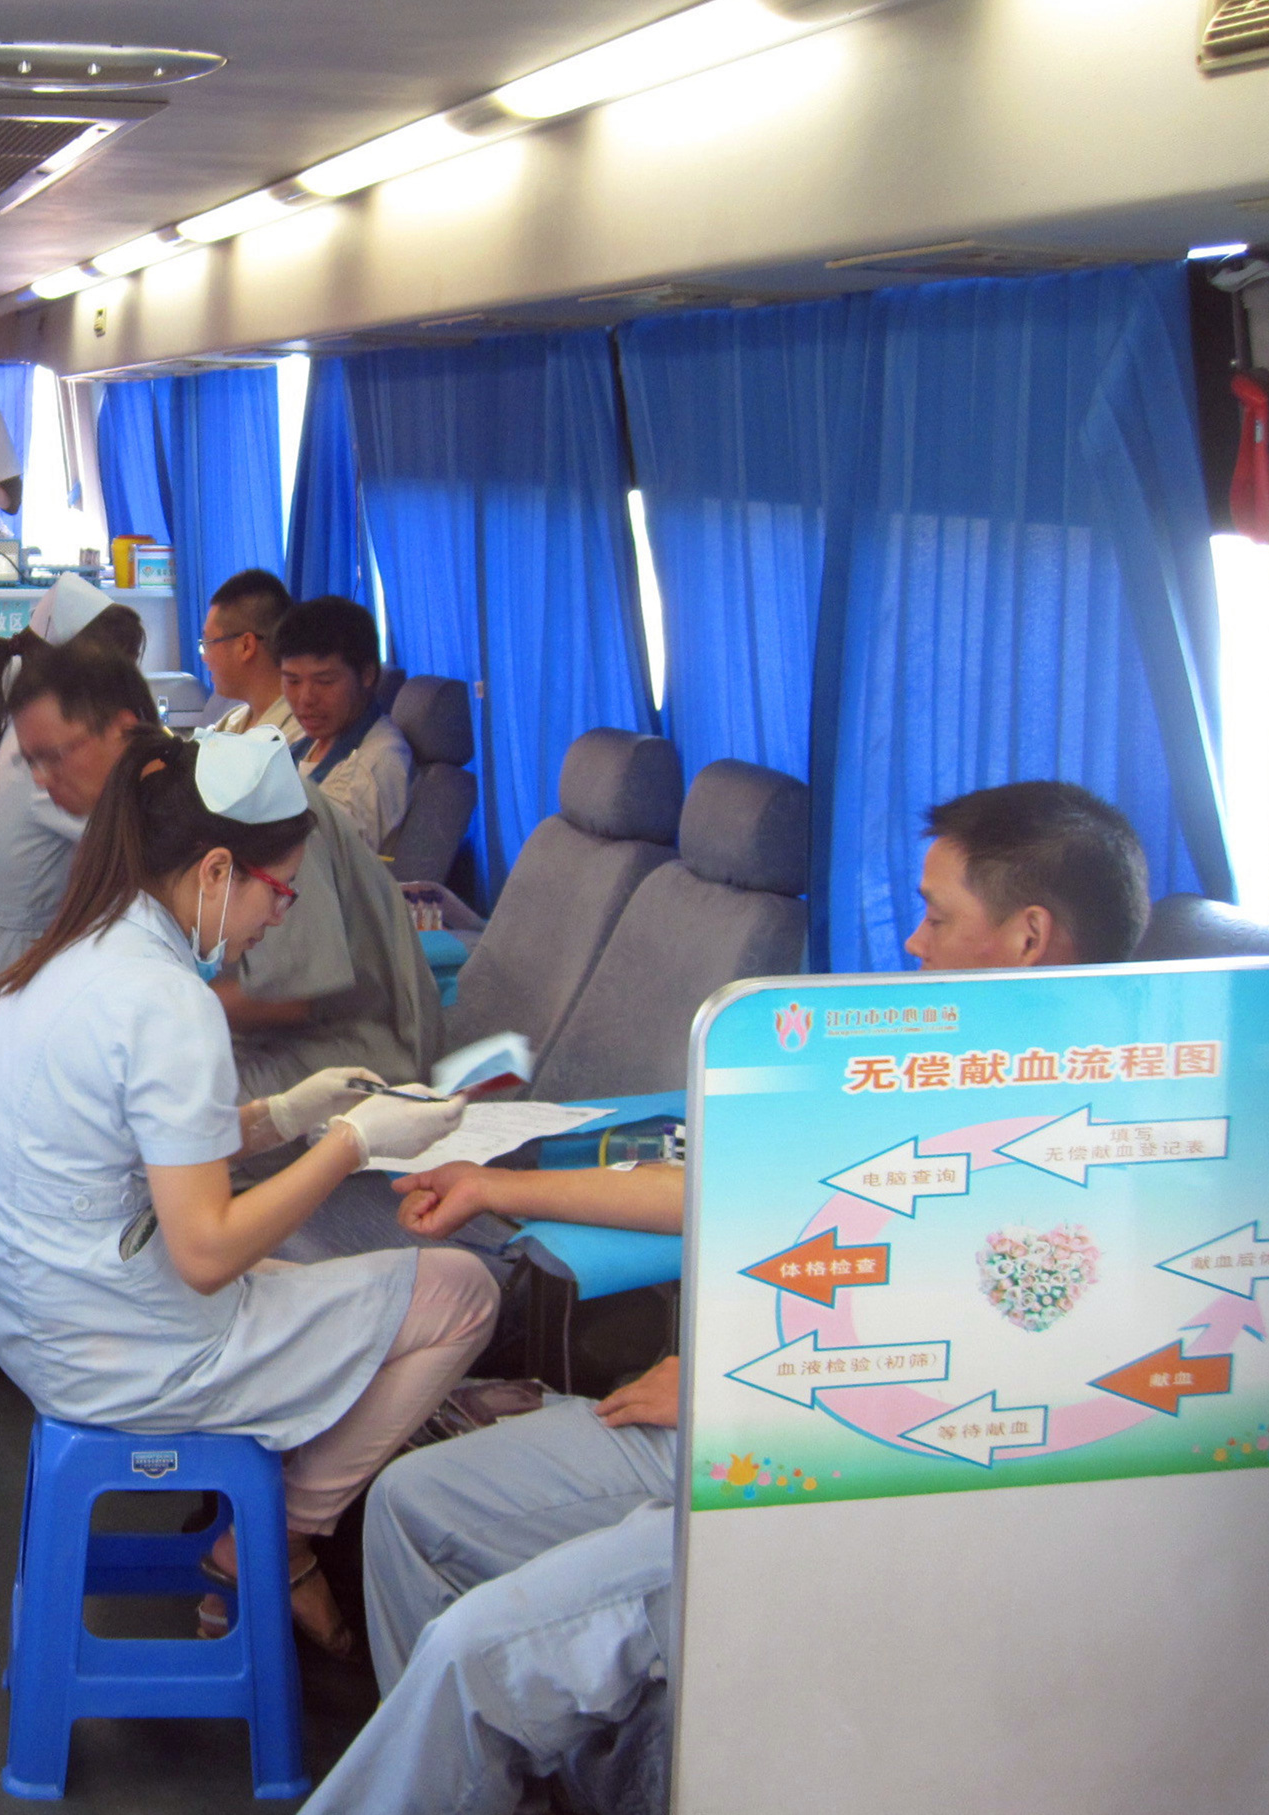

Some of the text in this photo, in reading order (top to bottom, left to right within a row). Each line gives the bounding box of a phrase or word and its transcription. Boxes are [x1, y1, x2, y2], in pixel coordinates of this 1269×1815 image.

[827, 1006, 958, 1027] 江门市中心血站
[849, 1042, 1218, 1092] 无偿献血流程图
[1109, 1126, 1154, 1142] 填写
[1044, 1139, 1205, 1163] 无偿献血登记表
[862, 1168, 957, 1187] 电脑查询
[779, 1258, 878, 1278] 体格检查
[1148, 1371, 1194, 1387] 献血
[937, 1420, 1030, 1441] 等待献血
